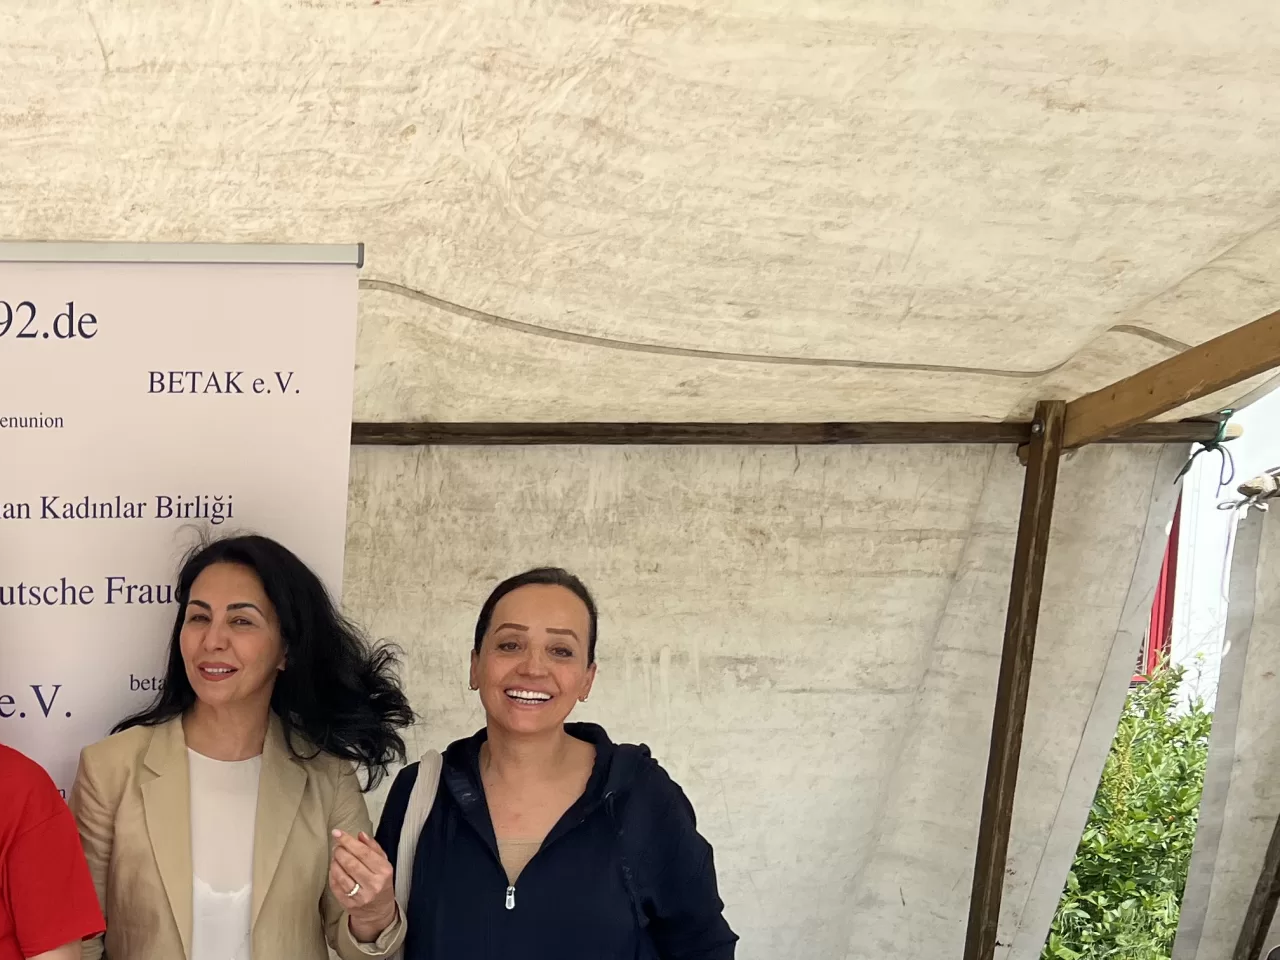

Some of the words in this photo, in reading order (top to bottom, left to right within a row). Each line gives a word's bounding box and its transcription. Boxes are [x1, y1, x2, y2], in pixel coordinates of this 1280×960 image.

[147, 370, 244, 395] BETAK
[251, 371, 301, 395] e.V.
[39, 495, 147, 520] Kadınlar
[154, 495, 235, 525] Birliği
